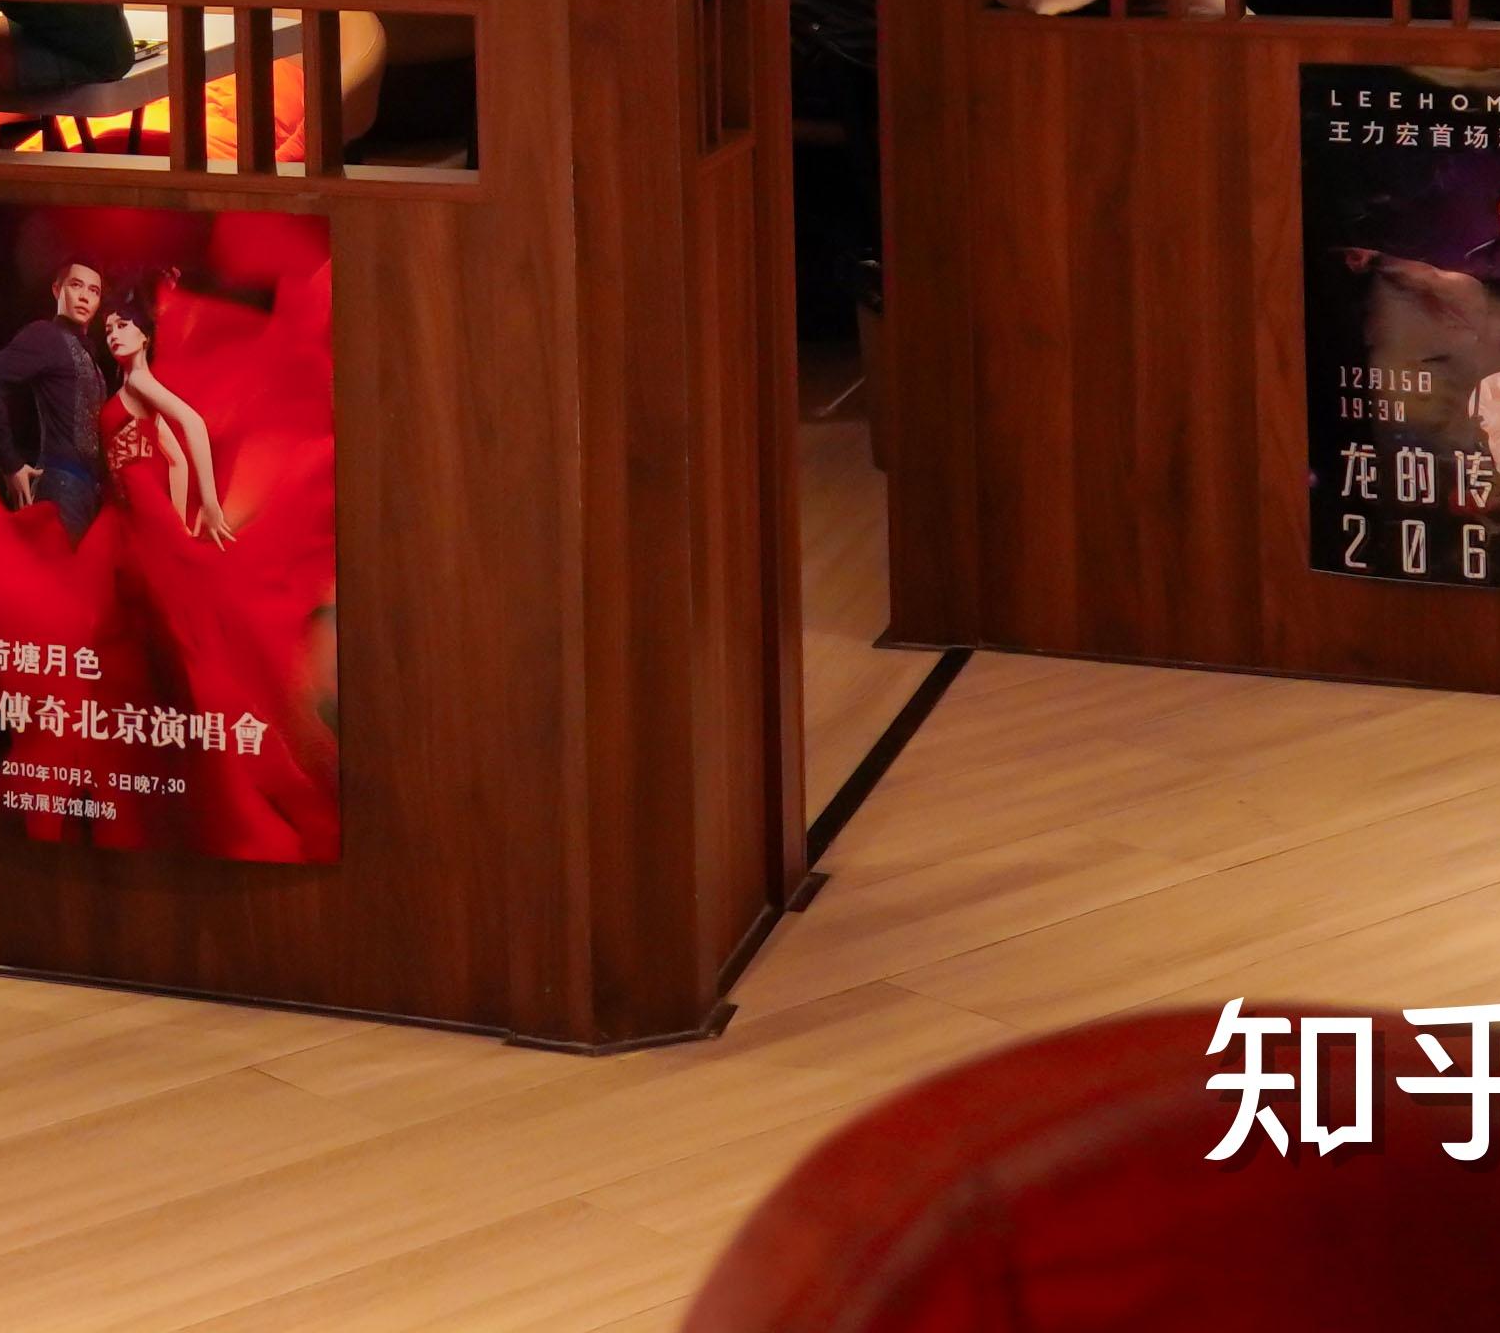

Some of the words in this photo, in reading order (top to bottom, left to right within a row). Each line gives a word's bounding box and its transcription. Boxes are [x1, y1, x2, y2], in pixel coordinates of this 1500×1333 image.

[1339, 365, 1434, 395] 12月15日
[1340, 397, 1406, 423] 19:30
[3, 790, 117, 821] 北京展览馆剧场
